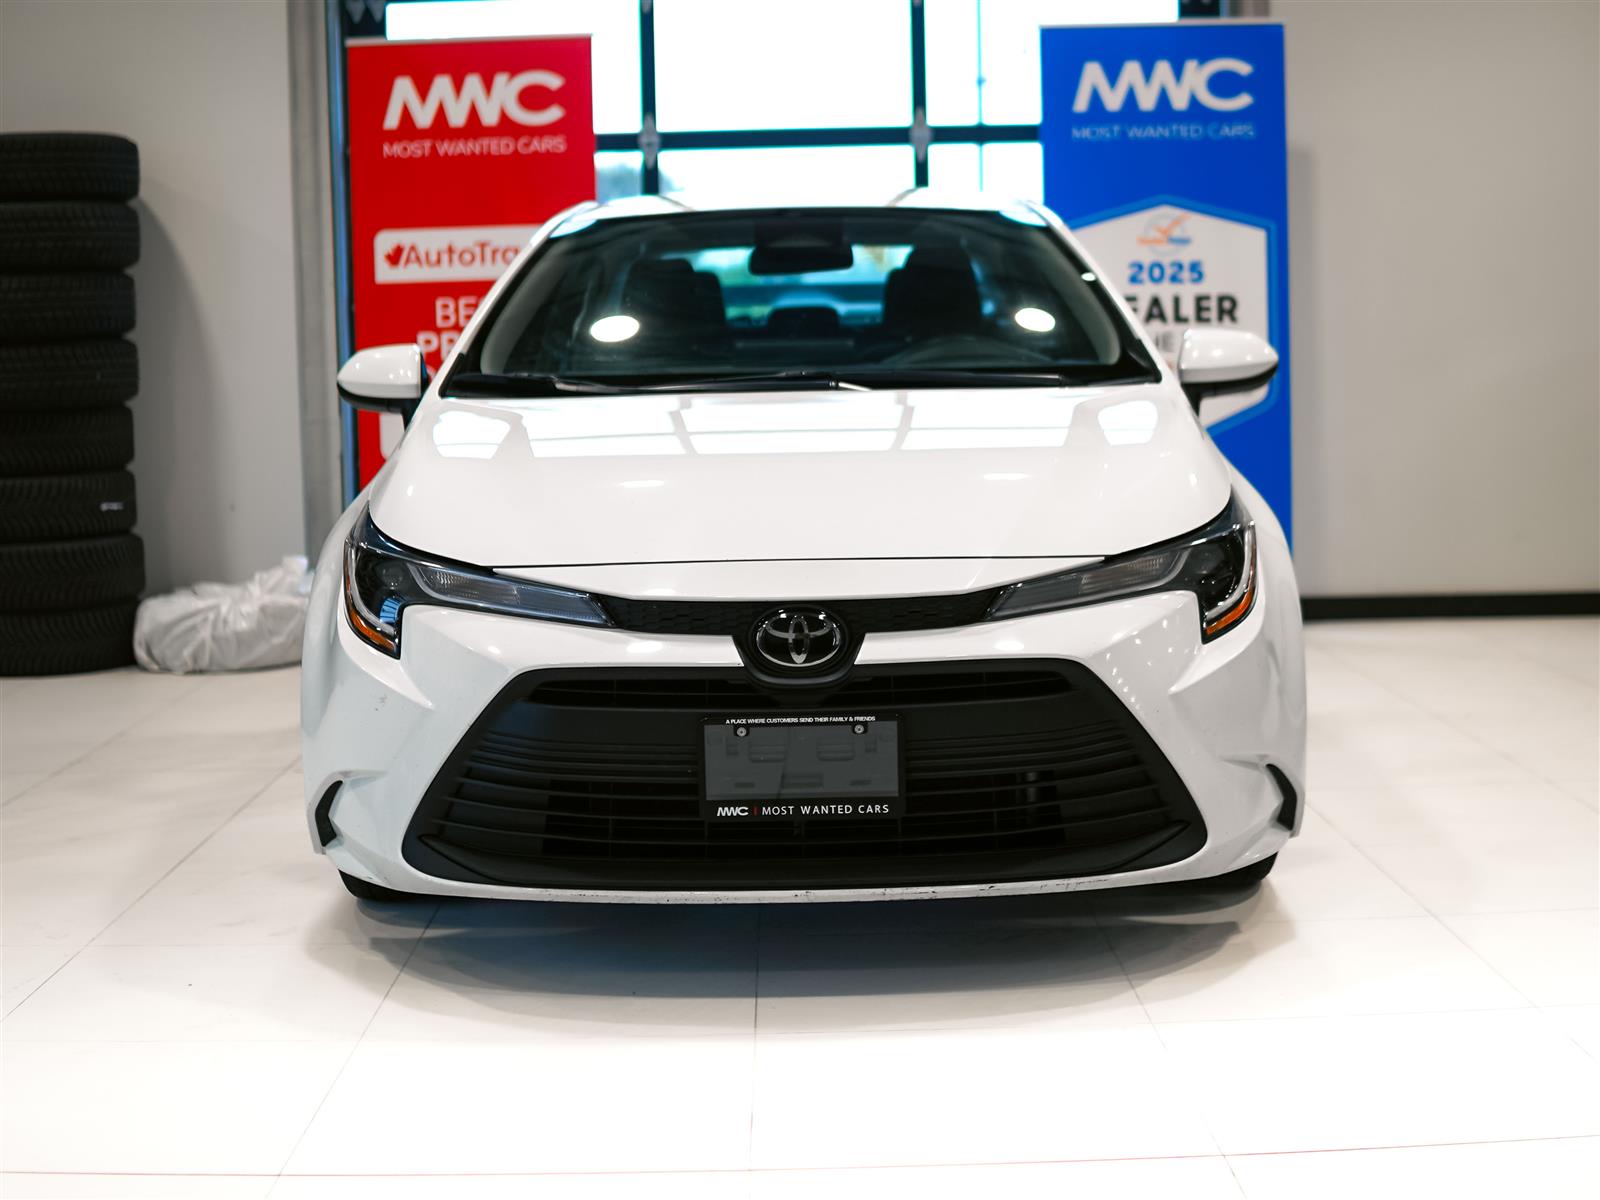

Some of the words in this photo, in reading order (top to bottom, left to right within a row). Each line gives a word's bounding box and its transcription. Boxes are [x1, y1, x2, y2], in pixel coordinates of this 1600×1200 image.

[1072, 57, 1254, 113] MWC
[382, 70, 566, 130] MWC
[1071, 124, 1120, 139] MOST
[1127, 123, 1202, 139] WANTED
[1207, 120, 1254, 137] CARS
[382, 140, 432, 159] MOST
[435, 137, 515, 156] WANTED
[517, 134, 568, 154] CARS
[1128, 260, 1205, 285] 2025
[716, 806, 749, 816] MWC
[762, 806, 794, 816] MOST
[800, 804, 852, 814] WANTED
[858, 804, 888, 814] CARS
